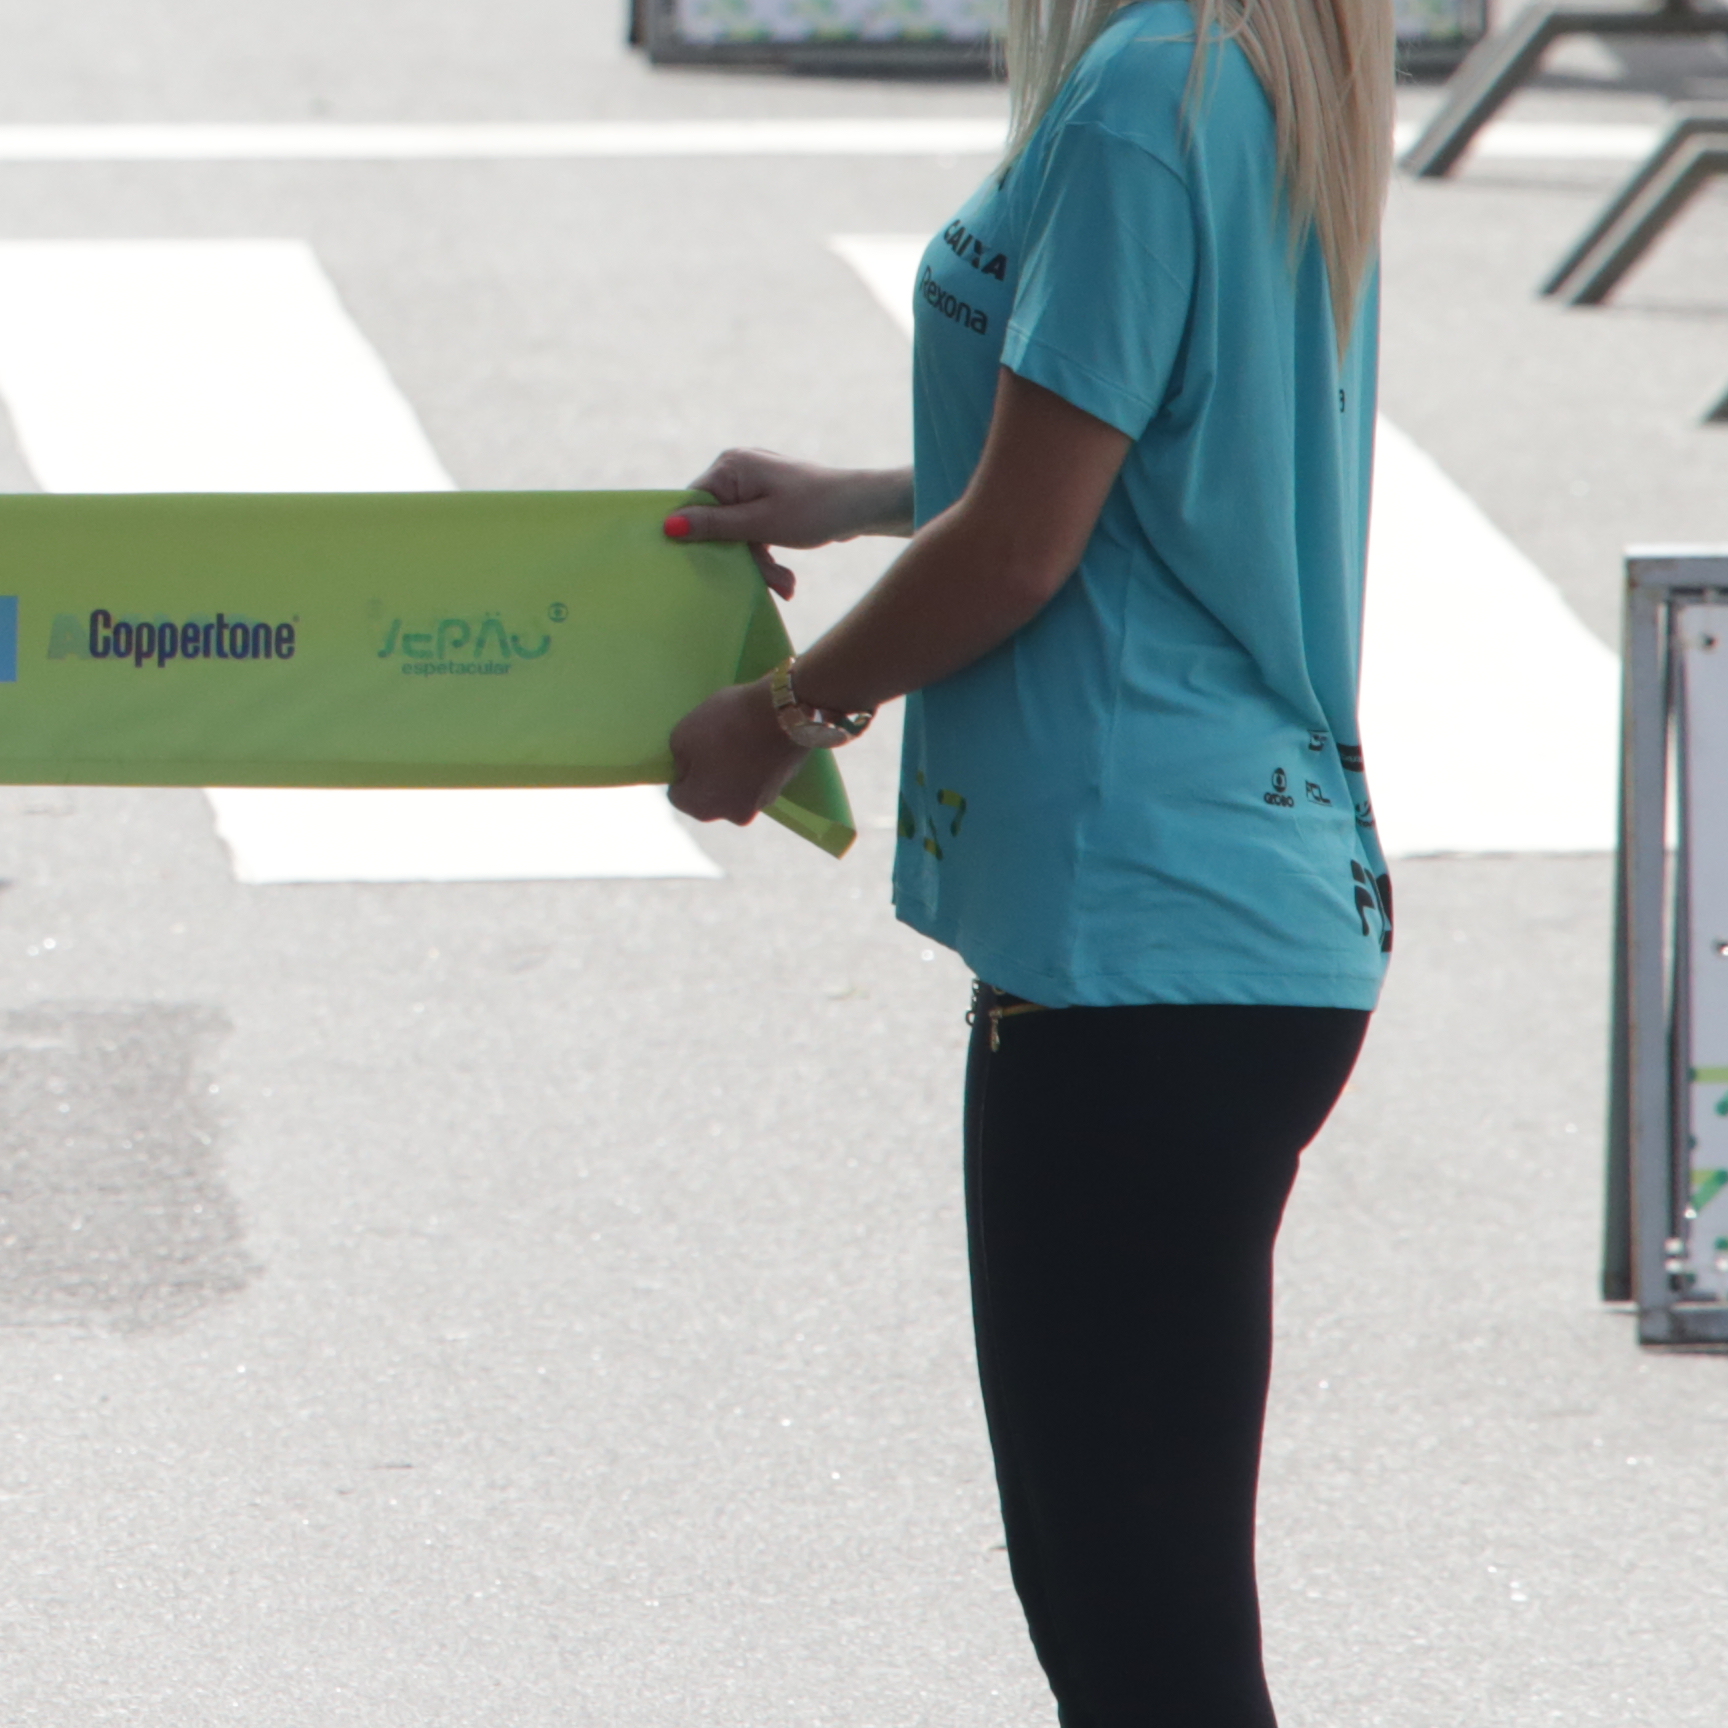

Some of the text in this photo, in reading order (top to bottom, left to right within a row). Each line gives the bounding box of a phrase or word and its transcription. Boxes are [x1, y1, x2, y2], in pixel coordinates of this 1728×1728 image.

[943, 219, 1007, 282] CAIXA
[919, 265, 988, 336] Rexona
[89, 609, 296, 668] Coppertone
